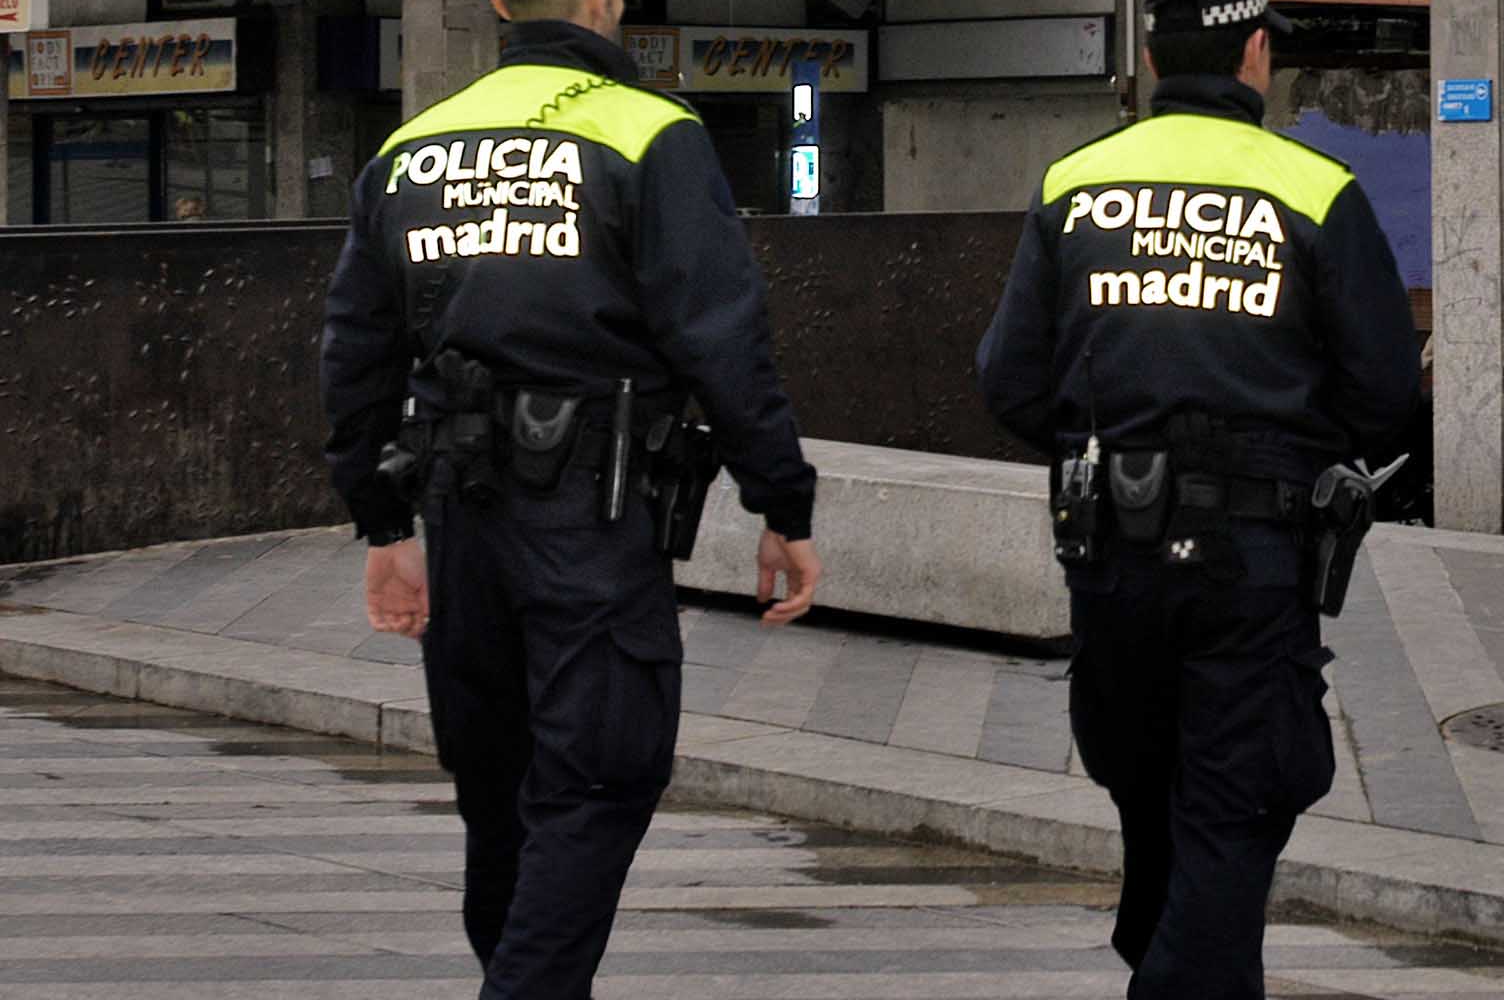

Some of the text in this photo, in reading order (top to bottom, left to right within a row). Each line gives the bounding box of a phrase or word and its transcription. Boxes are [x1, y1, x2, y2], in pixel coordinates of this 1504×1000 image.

[90, 32, 211, 81] CENTER
[386, 137, 584, 194] POLICIA
[443, 180, 580, 210] MUNICIPAL
[1063, 188, 1285, 243] POLICIA
[407, 208, 581, 263] madrid
[1131, 230, 1283, 270] MUNICIPAL
[1089, 260, 1282, 318] madrid
